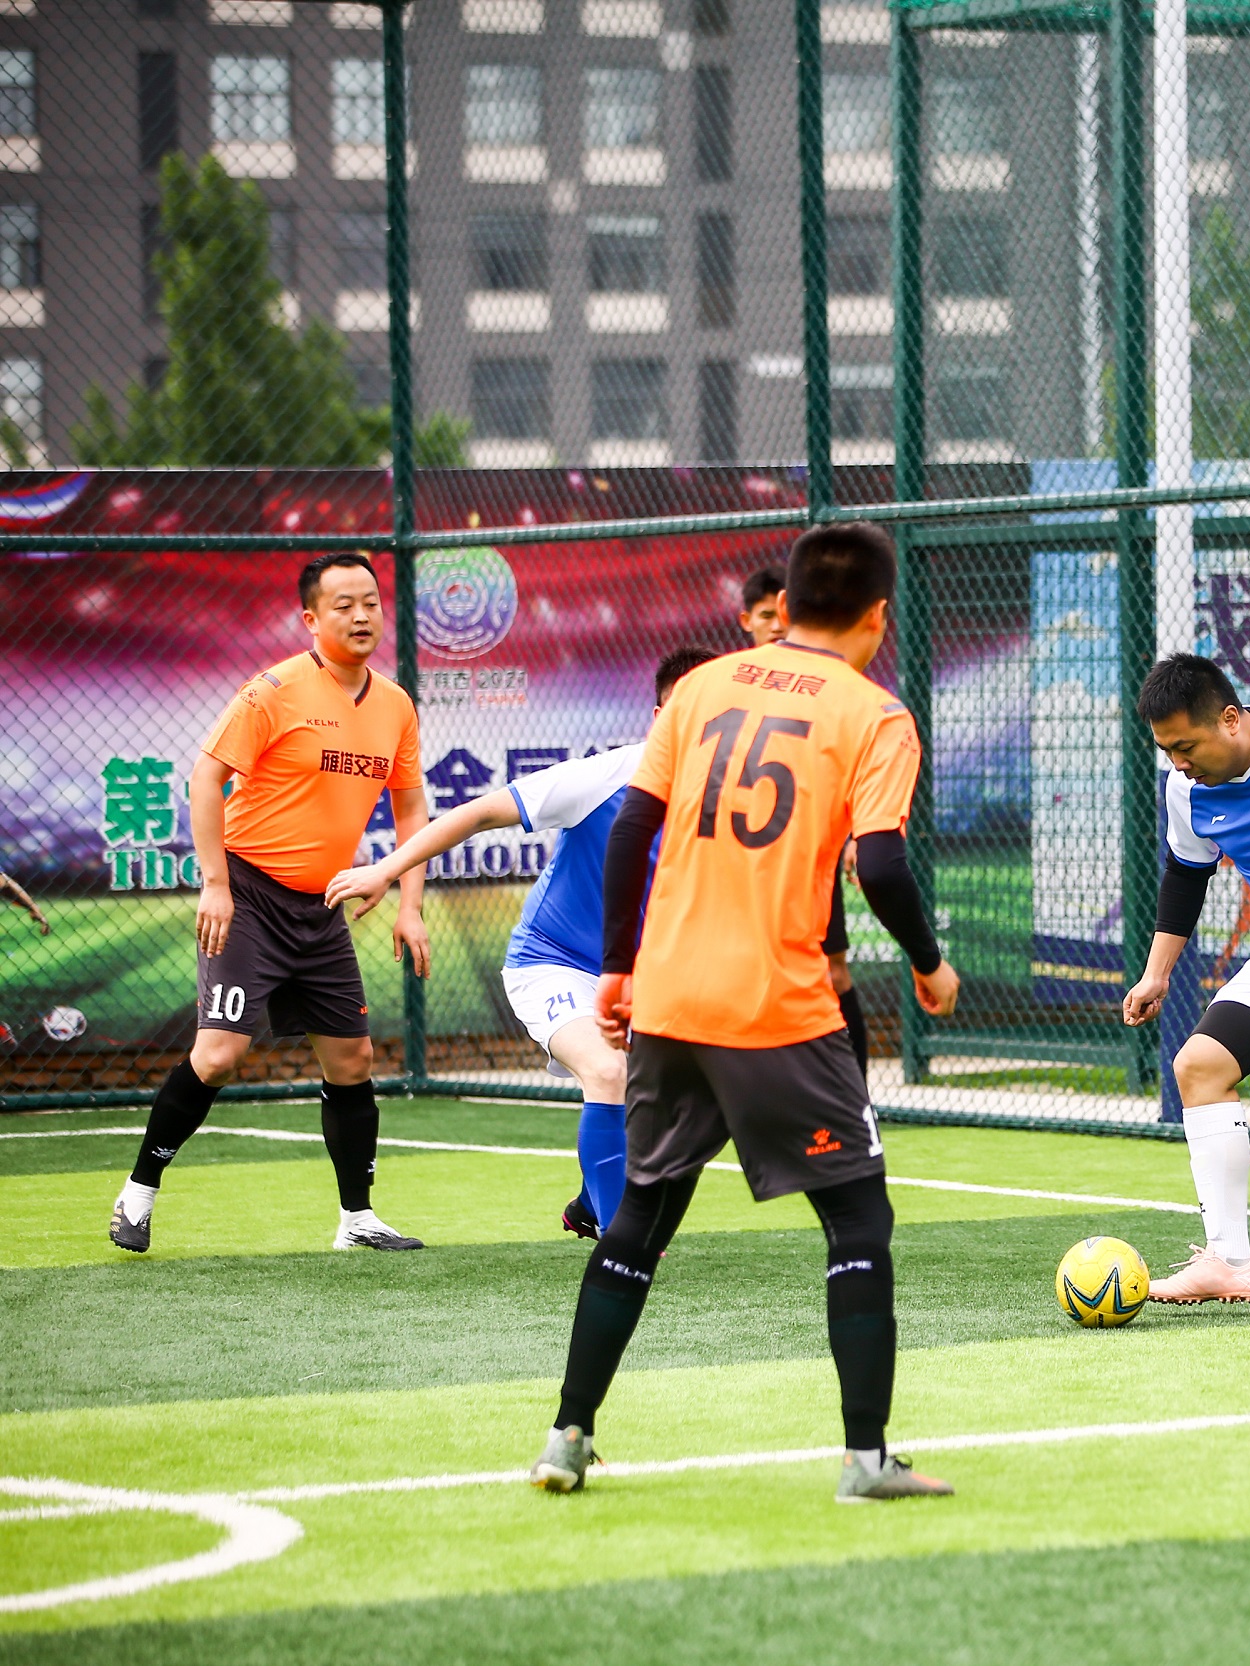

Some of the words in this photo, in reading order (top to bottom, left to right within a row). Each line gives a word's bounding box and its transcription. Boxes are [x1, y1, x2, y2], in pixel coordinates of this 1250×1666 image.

[305, 718, 341, 728] KELME
[319, 749, 390, 781] 雁塔交警
[697, 707, 814, 850] 15
[207, 983, 246, 1022] 10
[545, 991, 576, 1022] 24
[862, 1103, 884, 1158] 1
